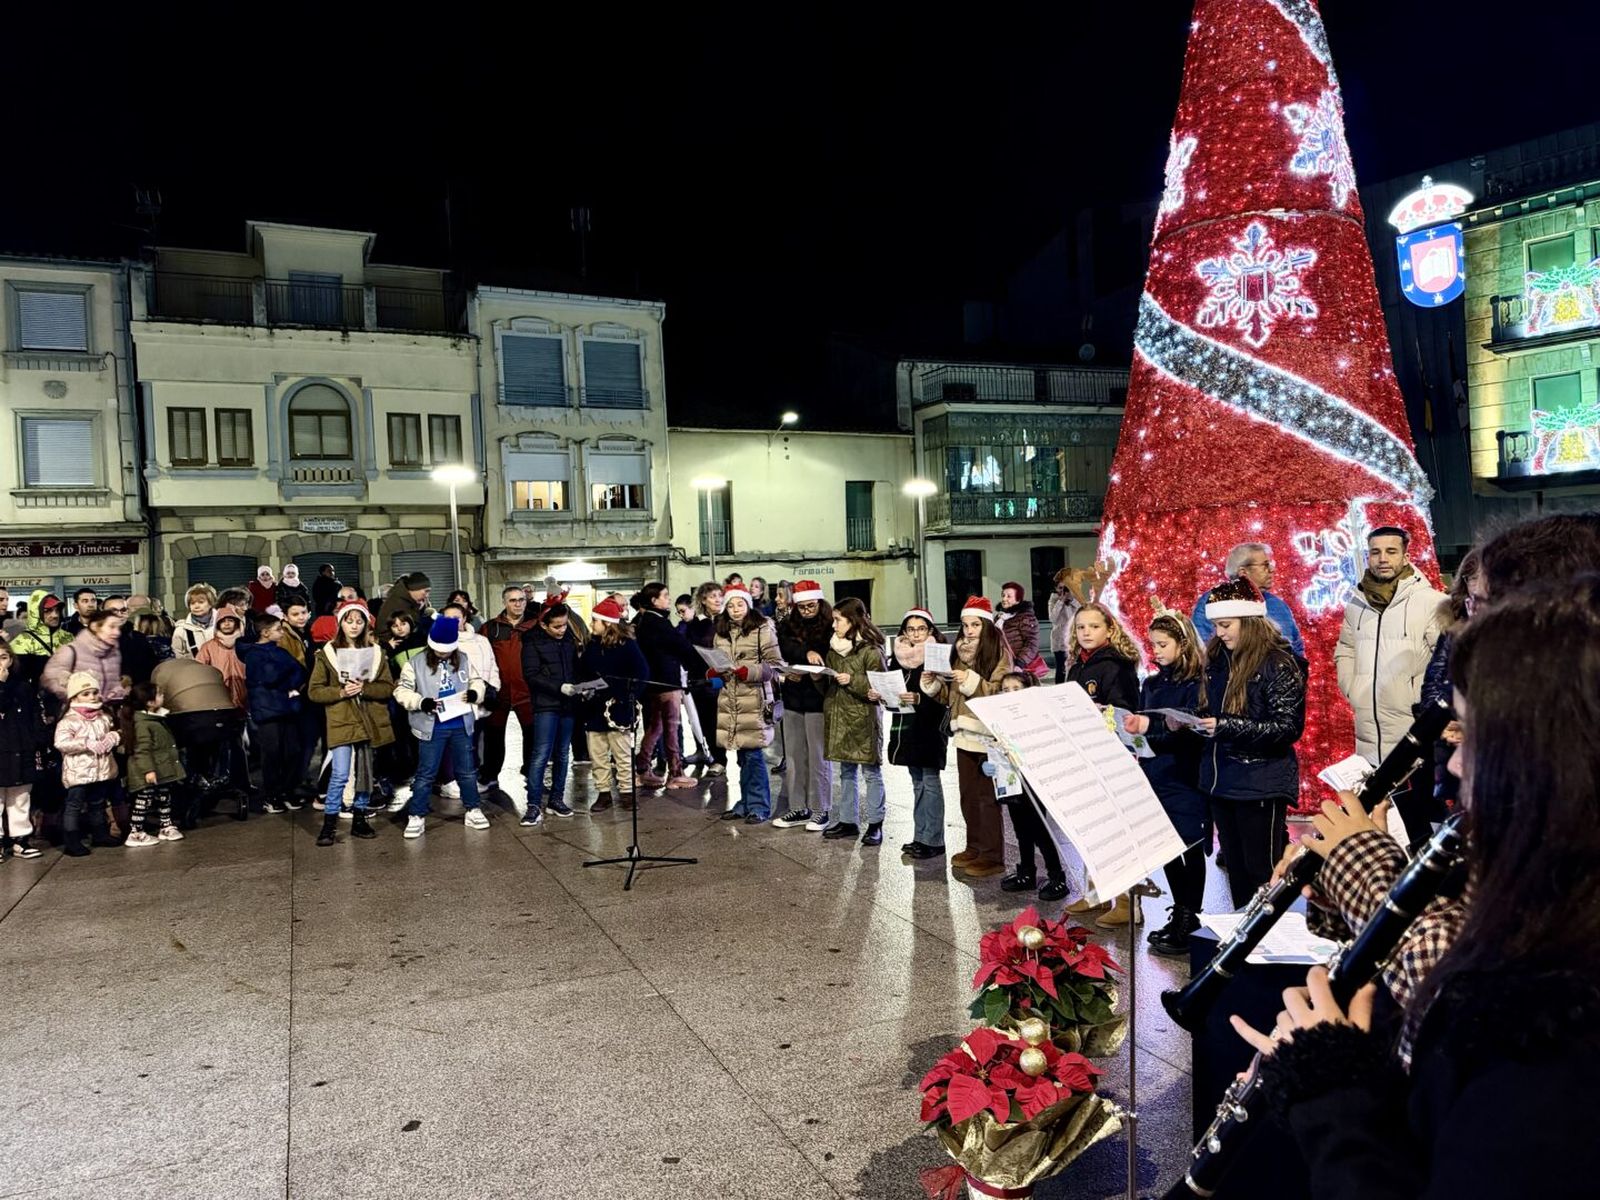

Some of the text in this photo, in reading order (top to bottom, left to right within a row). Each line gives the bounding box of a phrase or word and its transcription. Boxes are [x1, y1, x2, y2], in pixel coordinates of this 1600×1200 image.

[42, 545, 74, 555] Pedro
[793, 567, 834, 575] Farmacia
[82, 577, 110, 585] VIVAS
[458, 670, 468, 683] C
